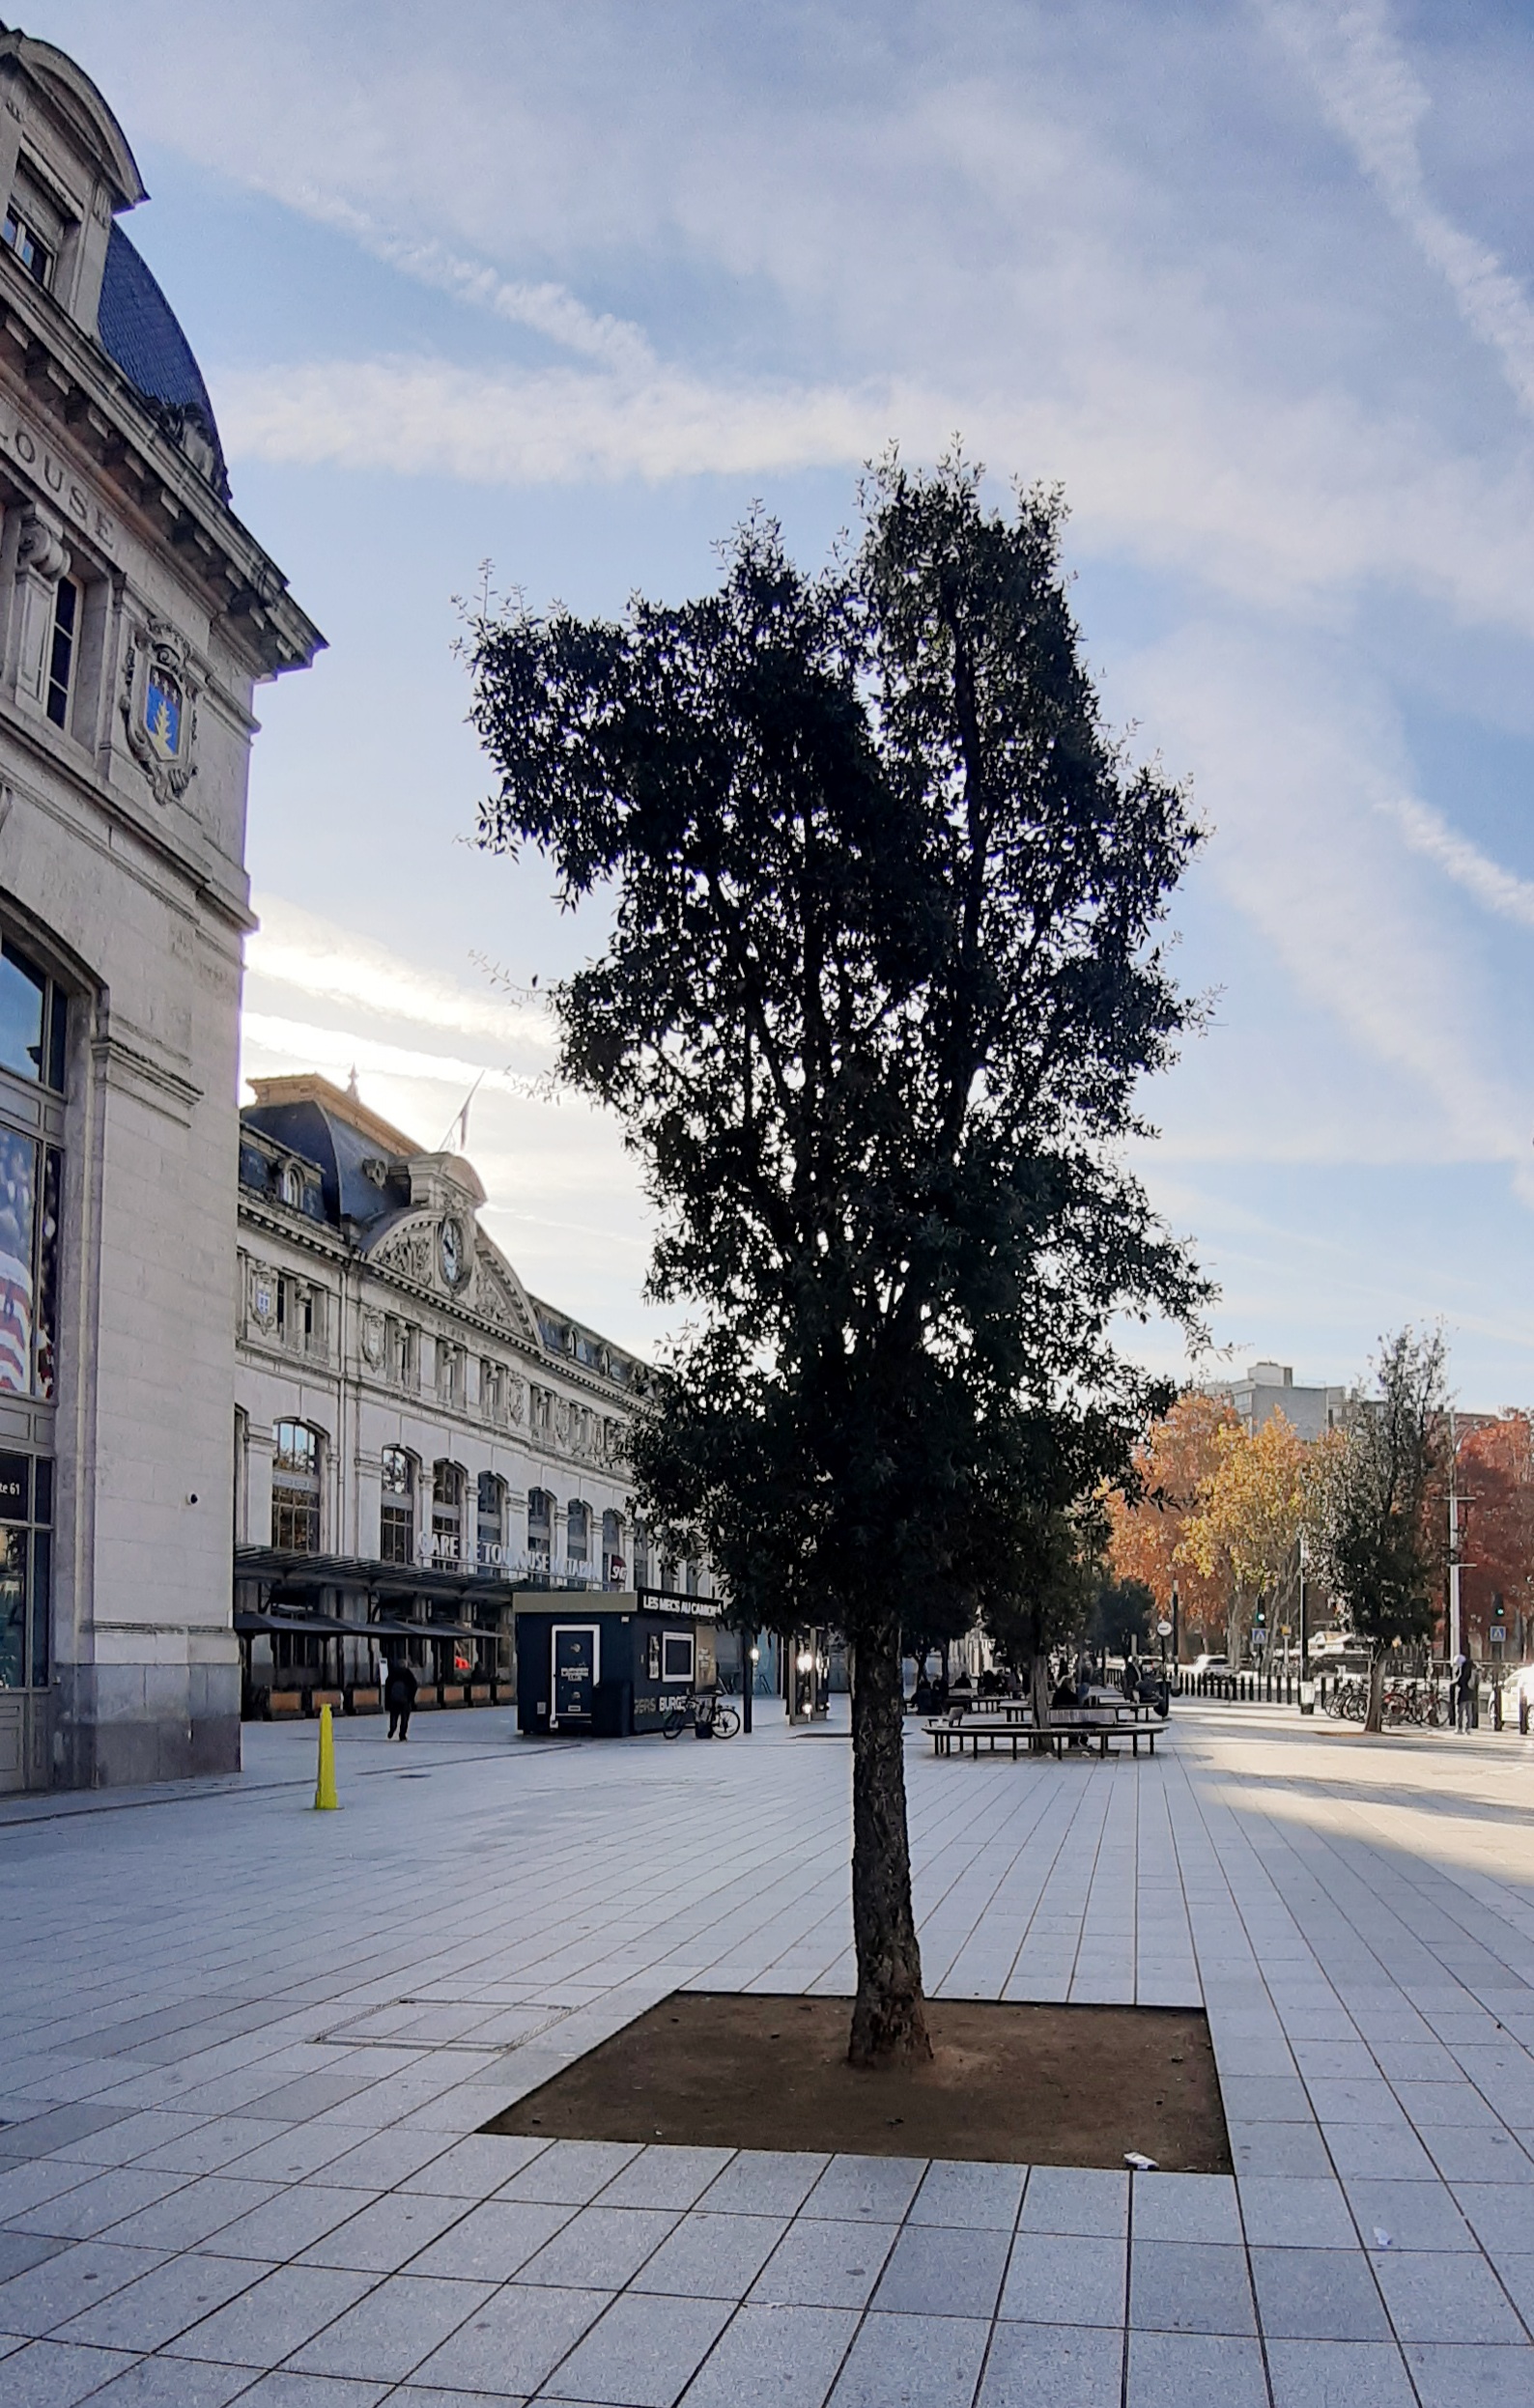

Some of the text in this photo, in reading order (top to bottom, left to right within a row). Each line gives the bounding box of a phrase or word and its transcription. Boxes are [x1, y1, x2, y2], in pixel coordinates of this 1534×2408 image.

[0, 431, 114, 550] OUSE
[10, 1482, 20, 1496] 61
[417, 1531, 459, 1559] GARE
[642, 1595, 659, 1610] LES
[659, 1598, 680, 1613] MECS
[681, 1601, 692, 1614] AU
